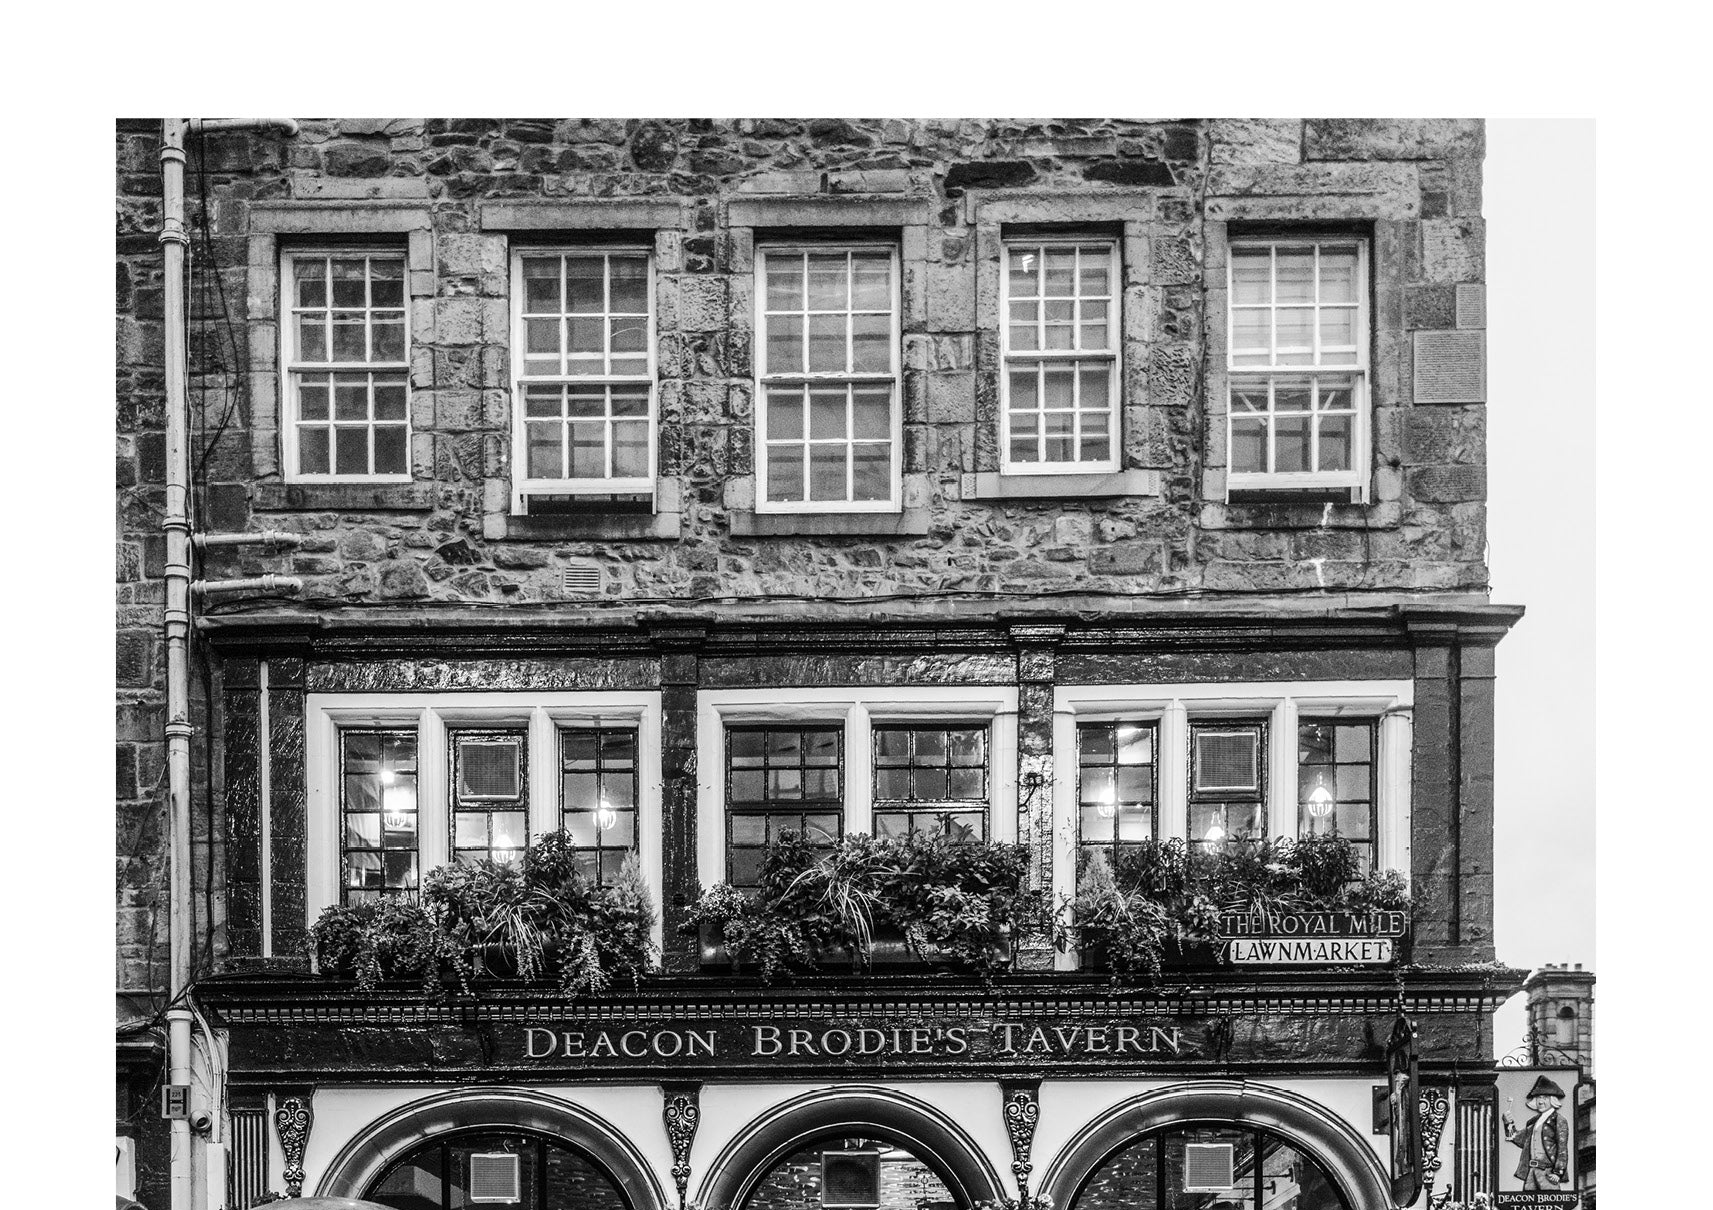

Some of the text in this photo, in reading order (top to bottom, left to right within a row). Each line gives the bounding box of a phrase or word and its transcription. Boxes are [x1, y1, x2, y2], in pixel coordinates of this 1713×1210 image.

[1222, 915, 1263, 934] THE
[1270, 915, 1340, 934] ROYAL
[1234, 941, 1387, 961] LAWNMARKET
[522, 1022, 1181, 1059] DEACON BRODIE'S TAVERN
[1498, 1193, 1577, 1204] DEACON BRODIE'S
